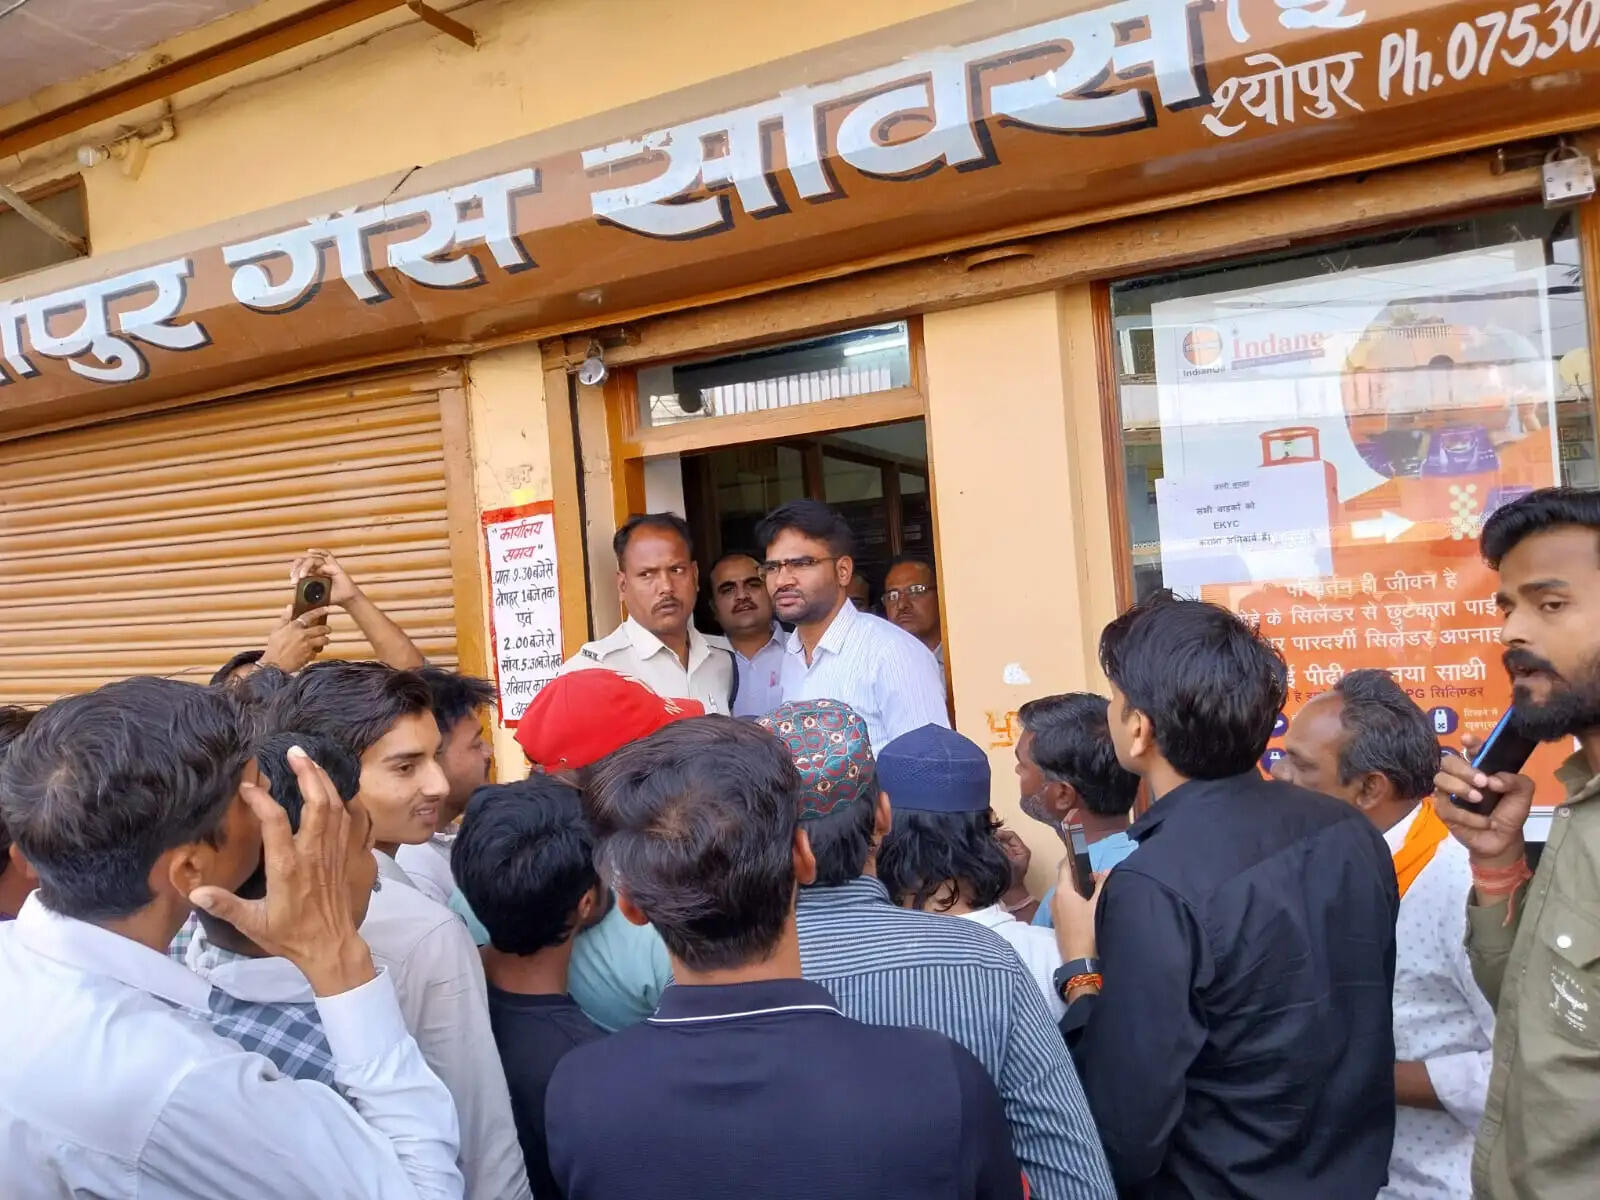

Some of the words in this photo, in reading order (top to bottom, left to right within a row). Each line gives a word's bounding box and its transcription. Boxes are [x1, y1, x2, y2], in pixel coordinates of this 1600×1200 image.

[1201, 51, 1365, 137] श्योपुर
[1378, 0, 1600, 100] Ph.07530
[1213, 520, 1240, 530] EKYC
[1384, 570, 1437, 591] जीवन
[515, 607, 534, 628] एवं
[1265, 608, 1281, 626] के
[1360, 601, 1377, 620] से
[1292, 628, 1357, 651] पारदर्शी
[1440, 627, 1502, 644] अपनाइ
[1433, 656, 1486, 681] साथी
[1406, 688, 1425, 698] PG
[1431, 685, 1484, 699] सिलिण्डर
